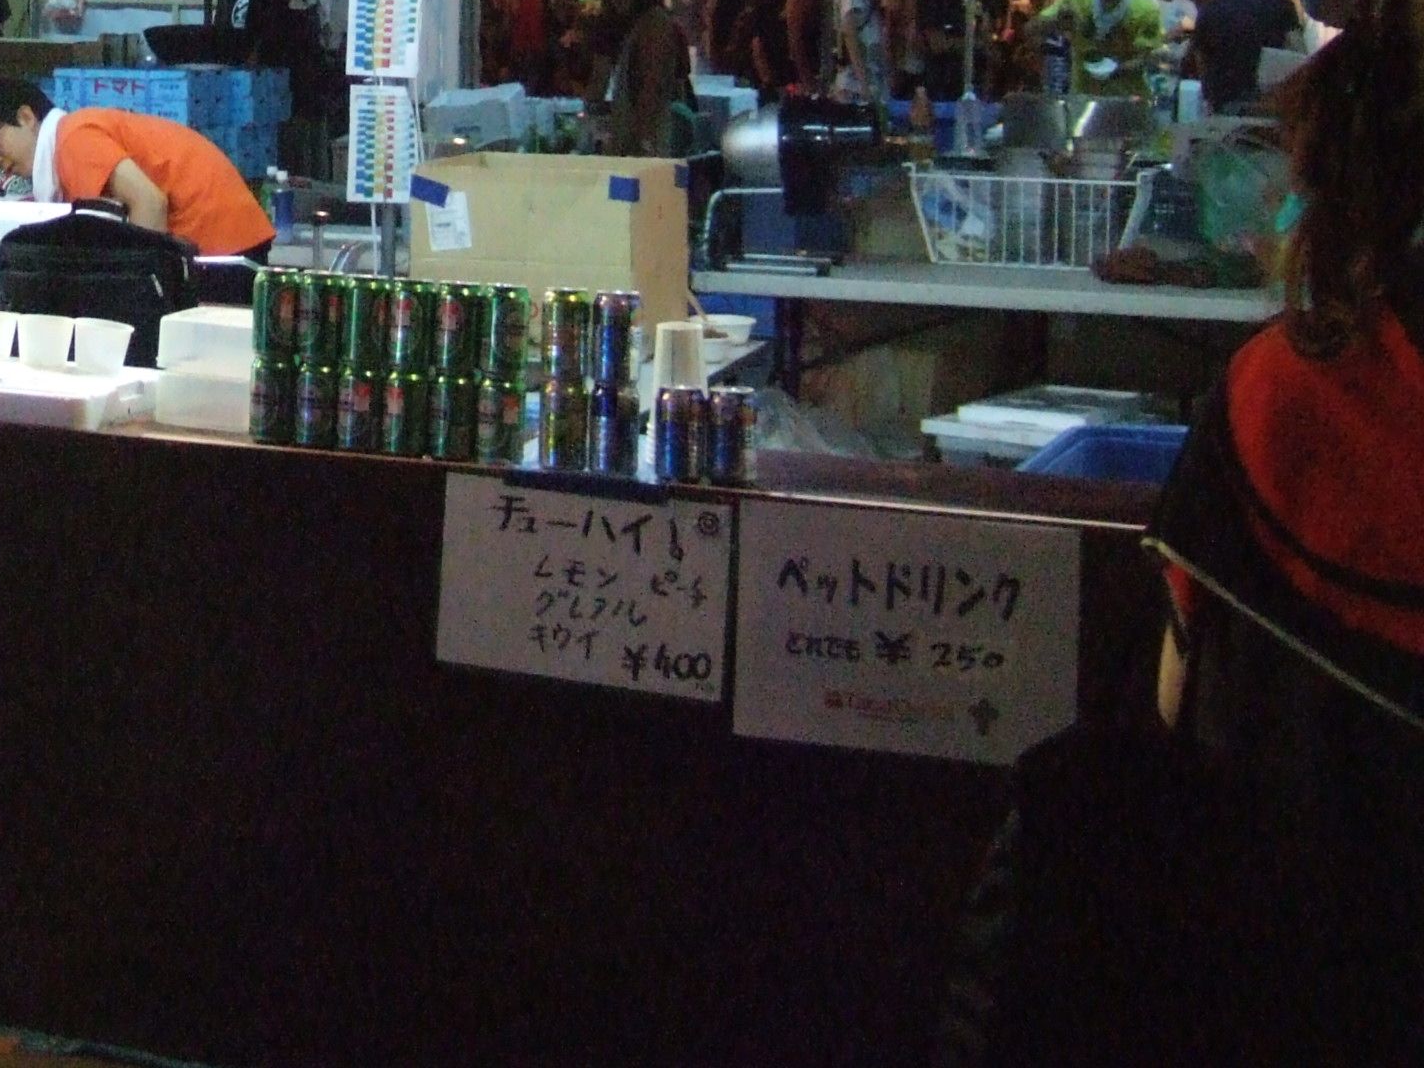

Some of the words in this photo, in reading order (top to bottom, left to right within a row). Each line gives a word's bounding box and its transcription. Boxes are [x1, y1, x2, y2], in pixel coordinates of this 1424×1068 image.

[93, 79, 146, 96] トマト
[533, 554, 618, 588] レモン
[777, 555, 1020, 622] ペットドリンク
[622, 642, 712, 682] ¥400
[875, 631, 1005, 672] ¥250
